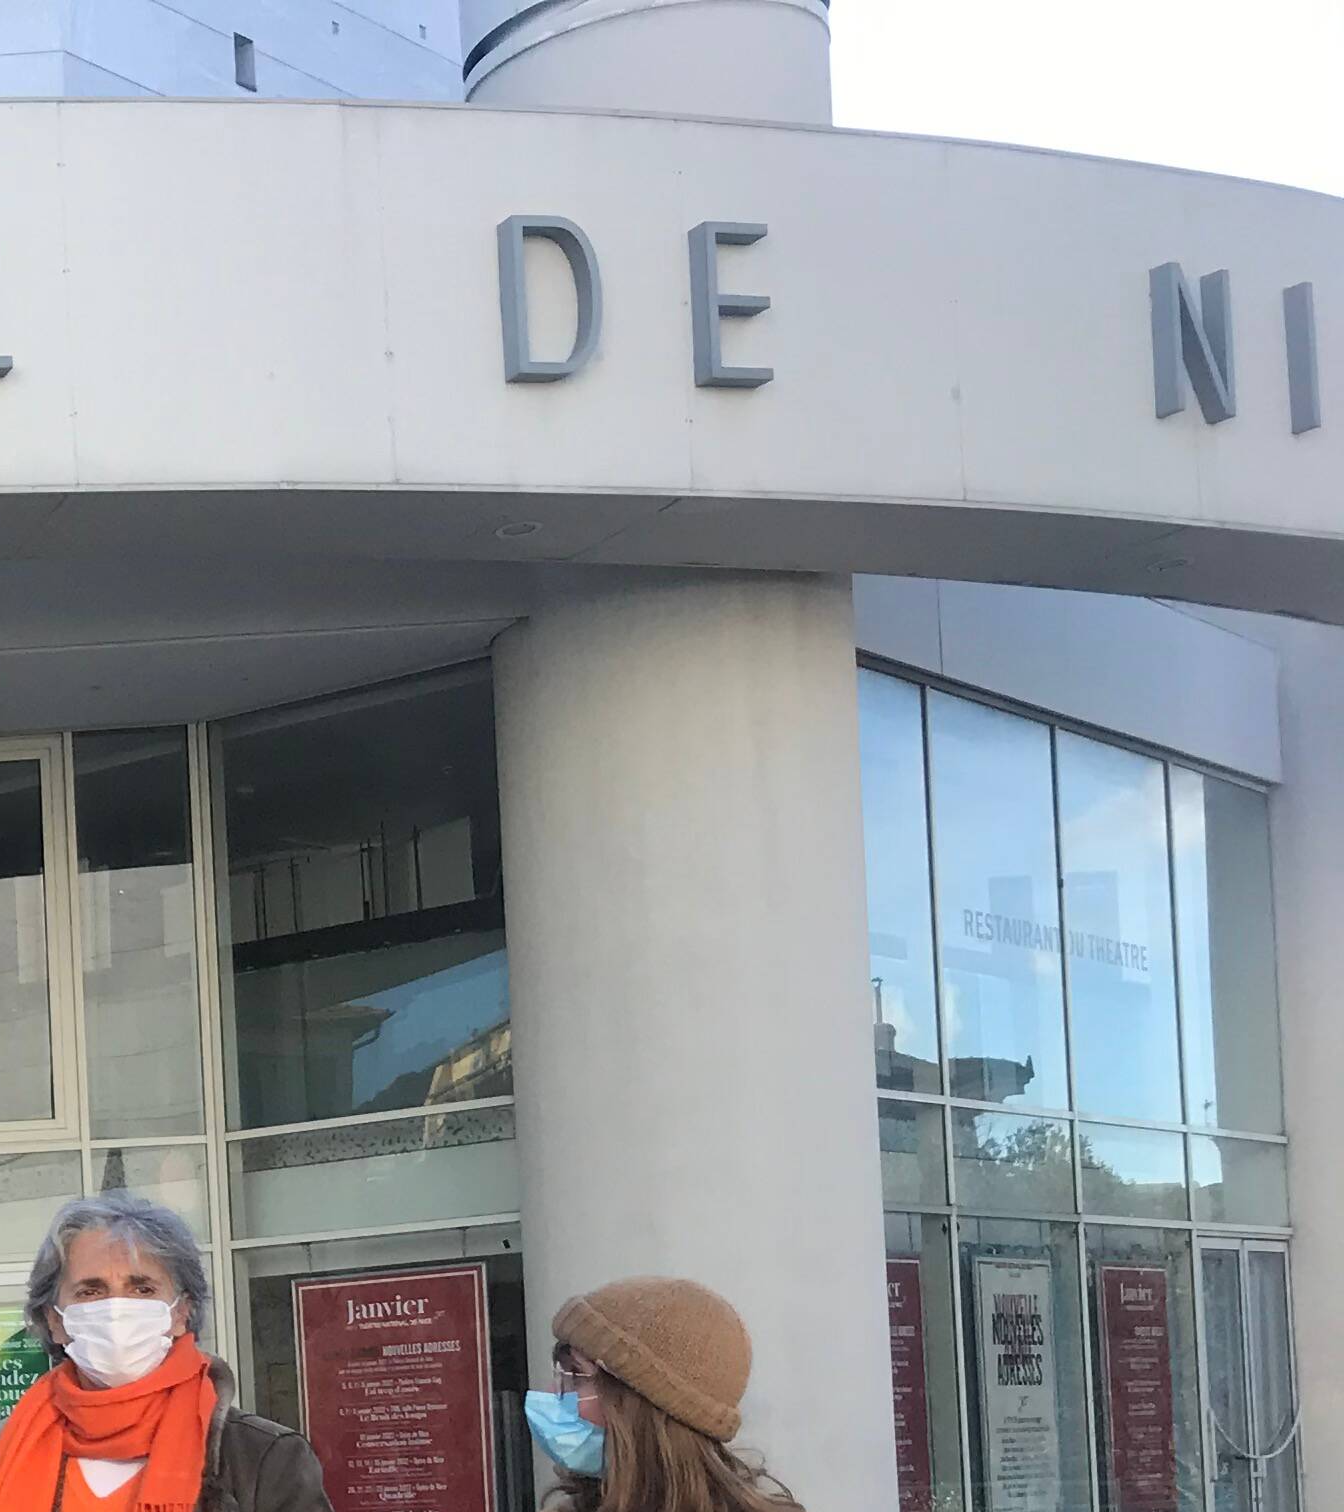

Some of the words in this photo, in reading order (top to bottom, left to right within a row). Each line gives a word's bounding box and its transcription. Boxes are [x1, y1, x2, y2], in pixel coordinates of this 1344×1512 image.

[497, 214, 774, 387] DE
[1150, 262, 1321, 434] NI
[963, 909, 1060, 954] RESTAURANT
[1088, 934, 1148, 971] THEATRE
[347, 1295, 429, 1325] Janvier
[383, 1343, 422, 1356] NOUVELLES
